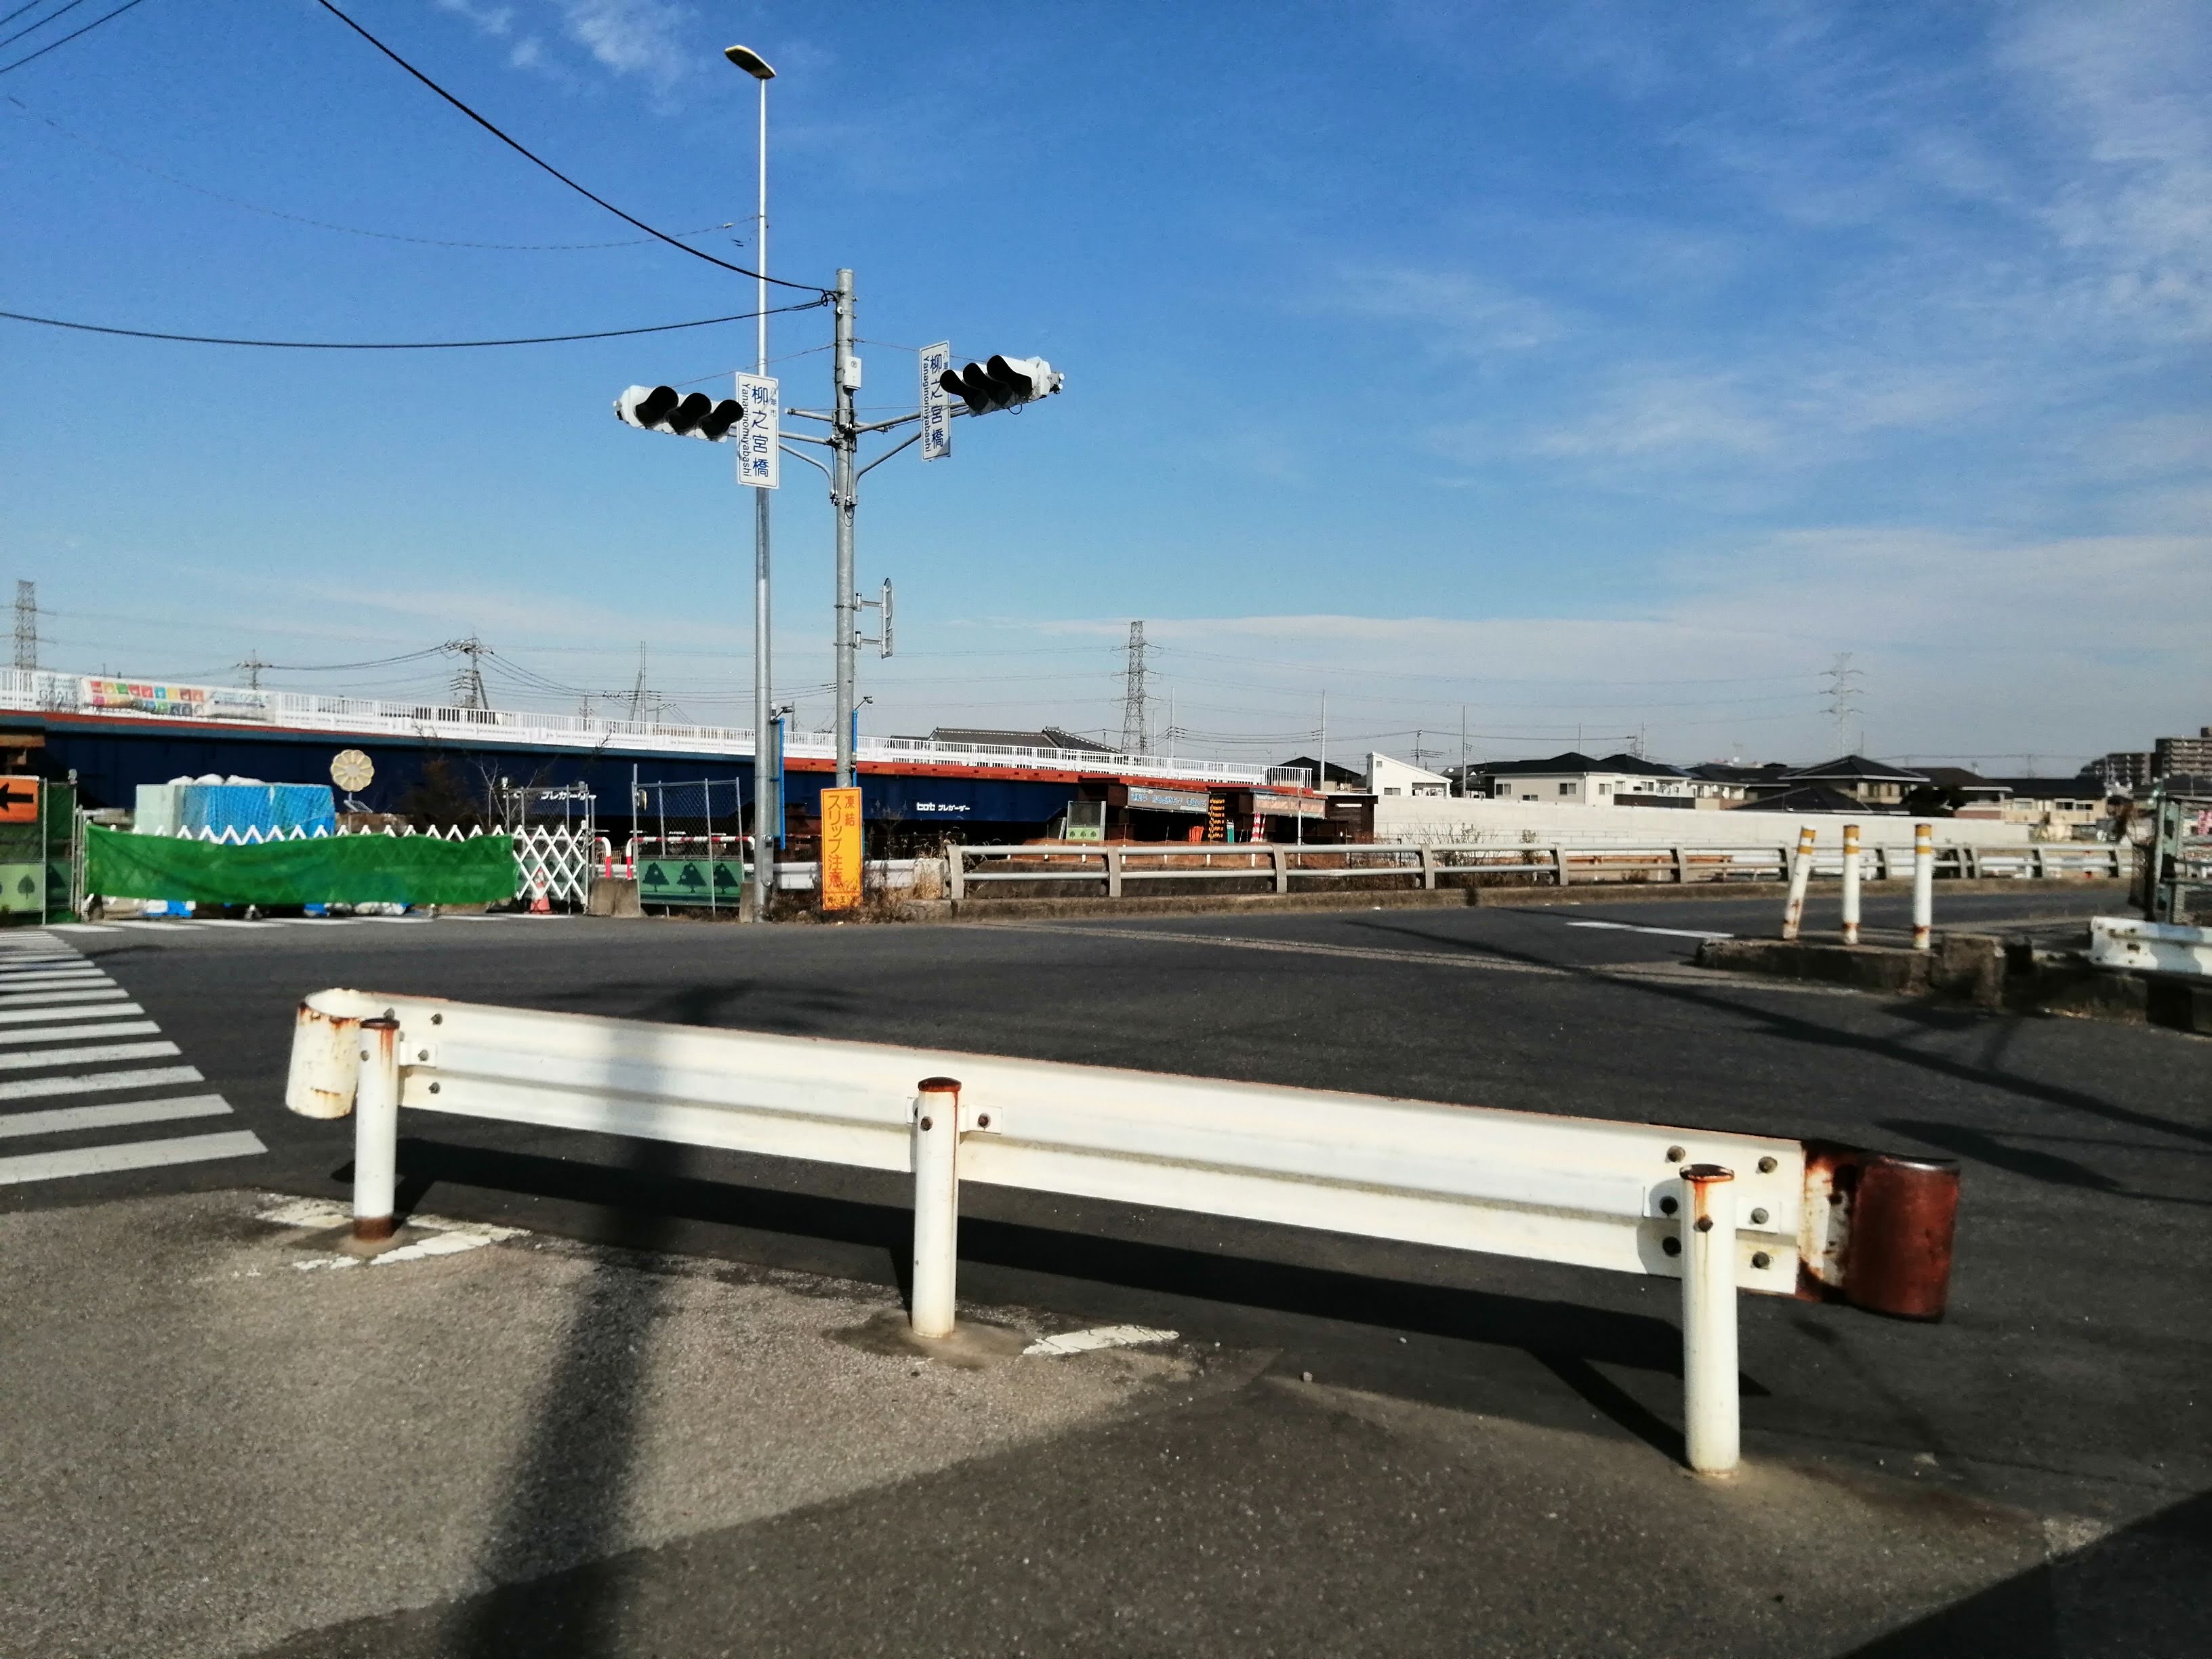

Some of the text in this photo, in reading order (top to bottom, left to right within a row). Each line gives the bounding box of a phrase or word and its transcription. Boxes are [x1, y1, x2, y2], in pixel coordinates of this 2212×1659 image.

[741, 383, 752, 477] Yanaginomiyabashi
[752, 385, 769, 478] 柳之宮橋
[922, 355, 933, 453] Yanaginomiyabashi
[930, 353, 944, 449] 柳之宮橋
[827, 795, 843, 887] スリップ注意
[844, 796, 855, 827] 凍結
